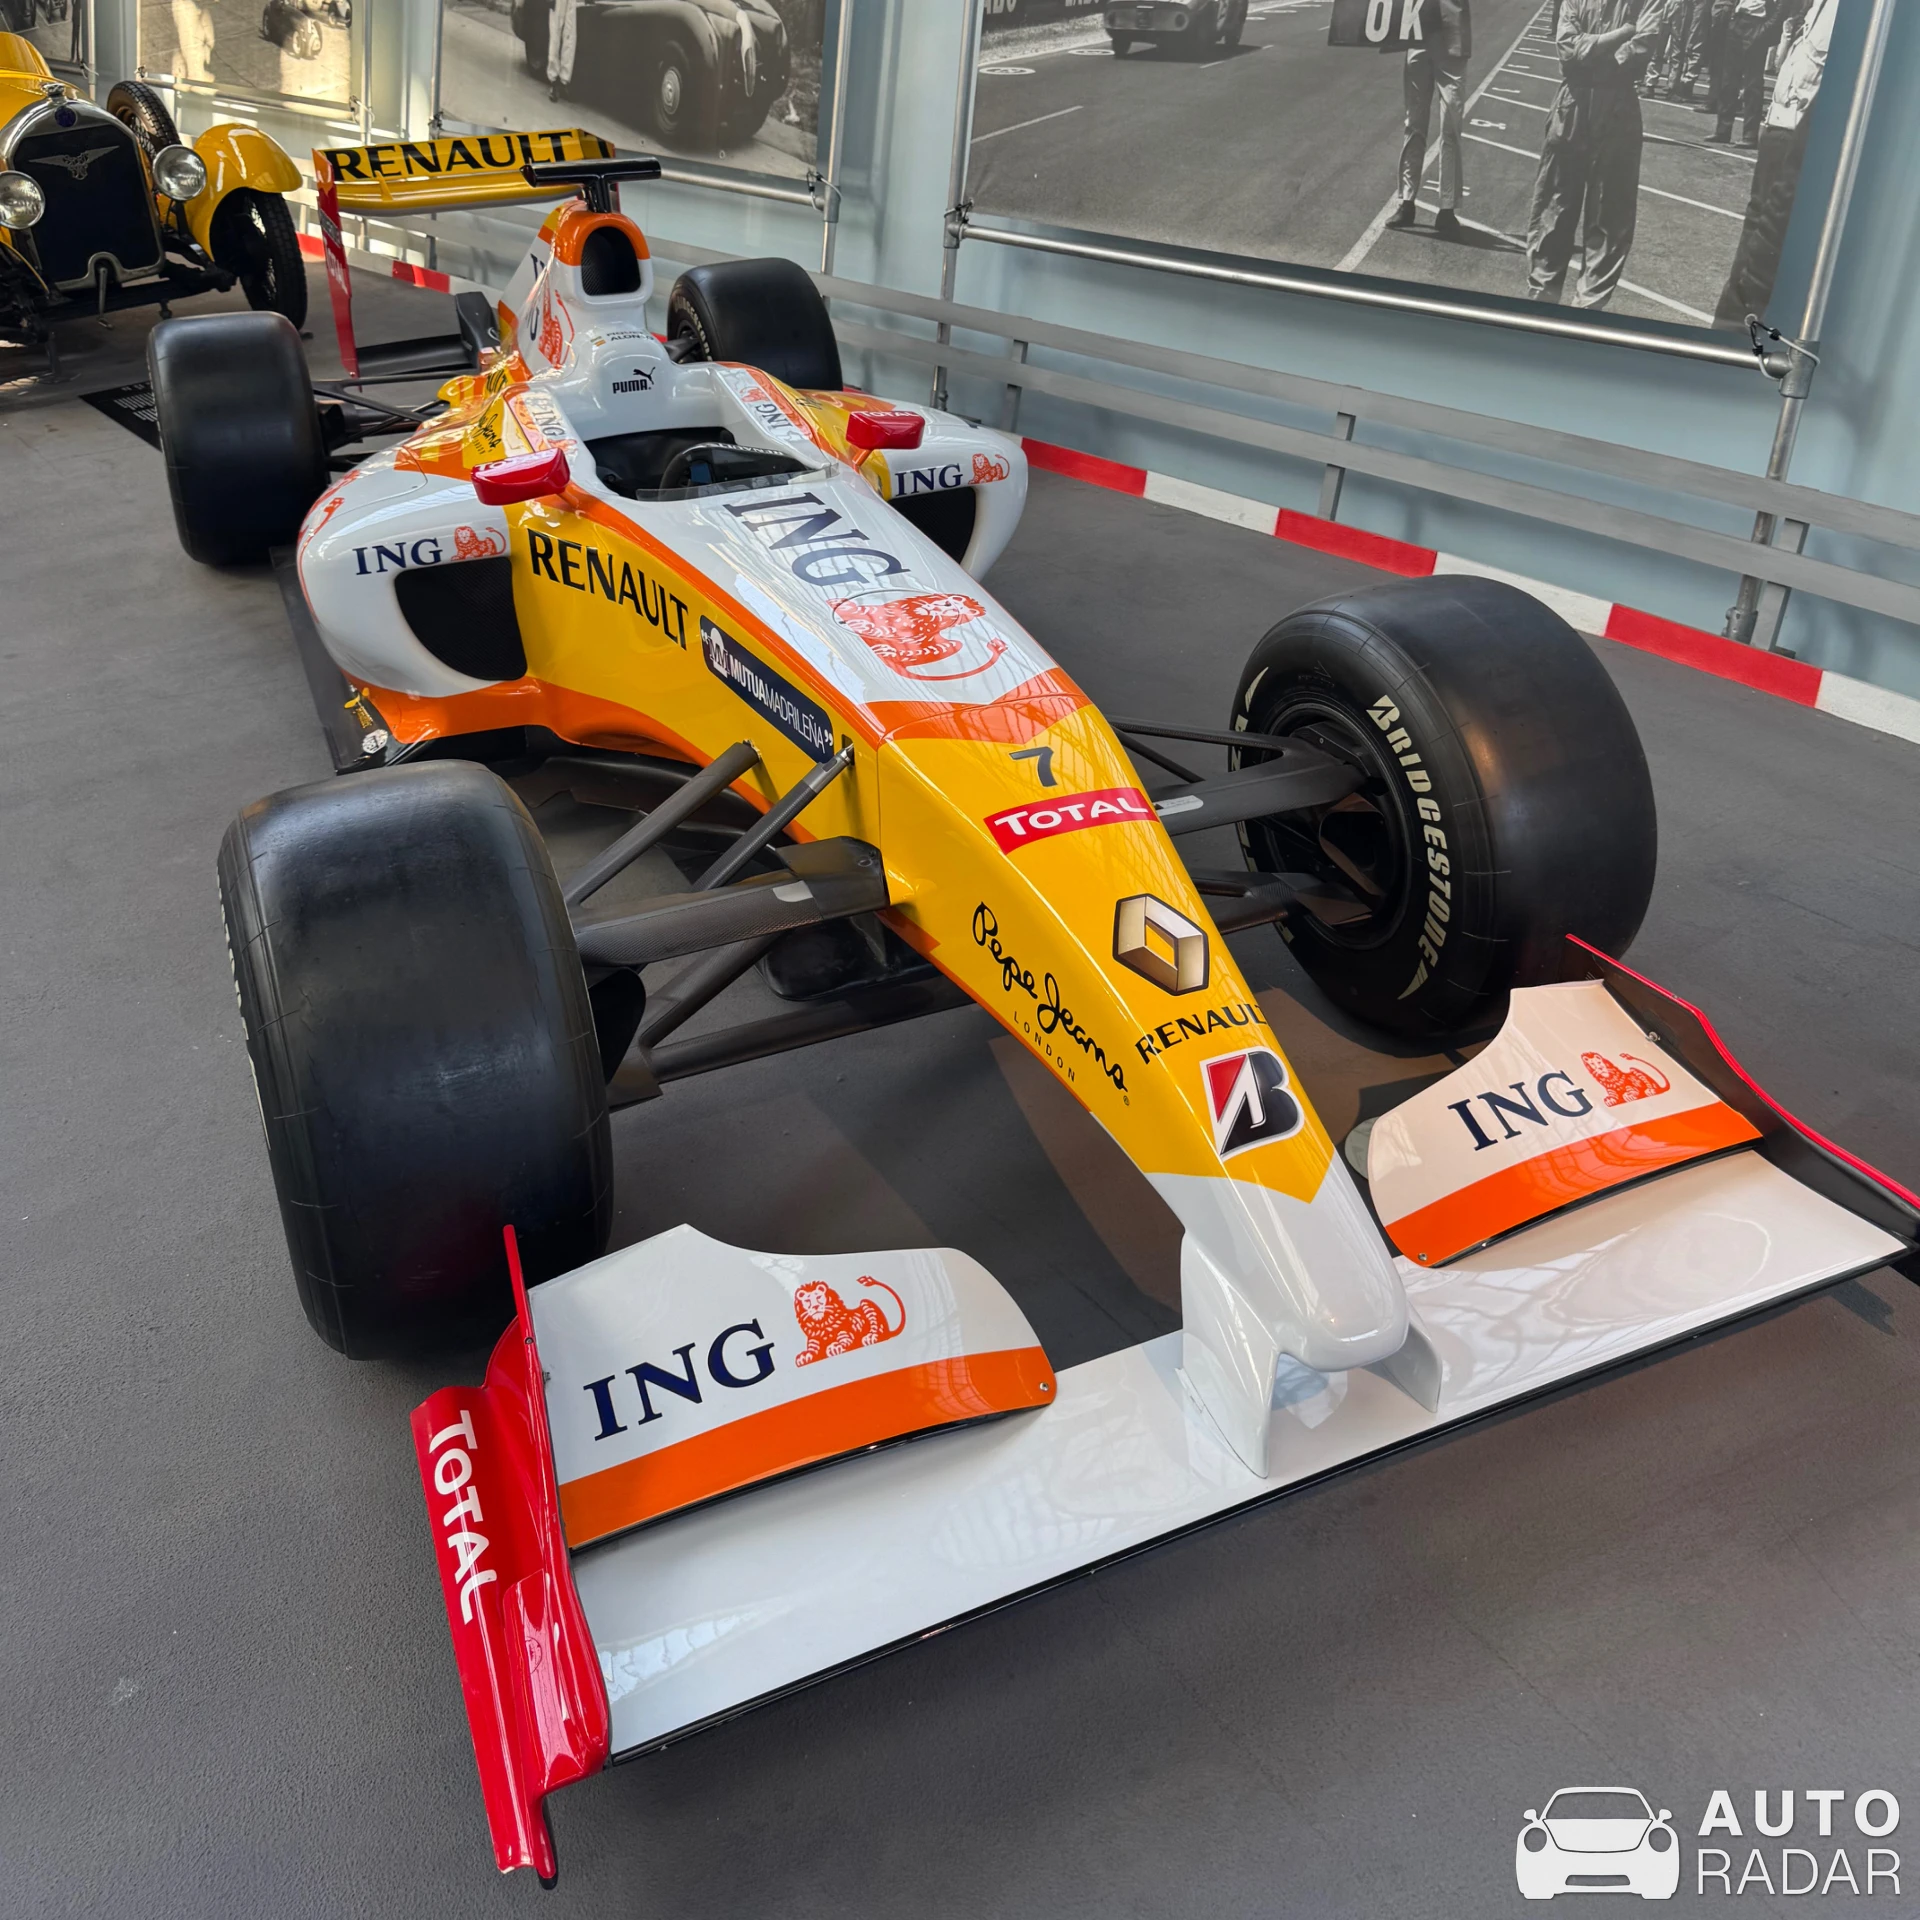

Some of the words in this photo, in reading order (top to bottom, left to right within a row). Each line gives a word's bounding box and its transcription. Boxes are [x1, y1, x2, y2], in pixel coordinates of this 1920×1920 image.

[1365, 0, 1424, 42] OK
[324, 131, 572, 181] RENAULT
[612, 379, 648, 394] PUMA
[532, 410, 566, 437] ING
[755, 403, 794, 429] ING
[894, 463, 964, 497] ING
[352, 537, 443, 575] ING
[722, 491, 911, 587] ING
[527, 528, 688, 651] RENAULT
[1008, 746, 1058, 787] 7
[994, 797, 1149, 836] TOTAL
[1366, 694, 1451, 967] BRIDGESTONE
[972, 901, 1038, 999] Pepe
[1037, 972, 1128, 1093] Jeans
[1014, 1011, 1075, 1082] LONDON
[1447, 1069, 1594, 1151] ING
[583, 1318, 775, 1441] ING
[428, 1409, 498, 1625] TOTAL
